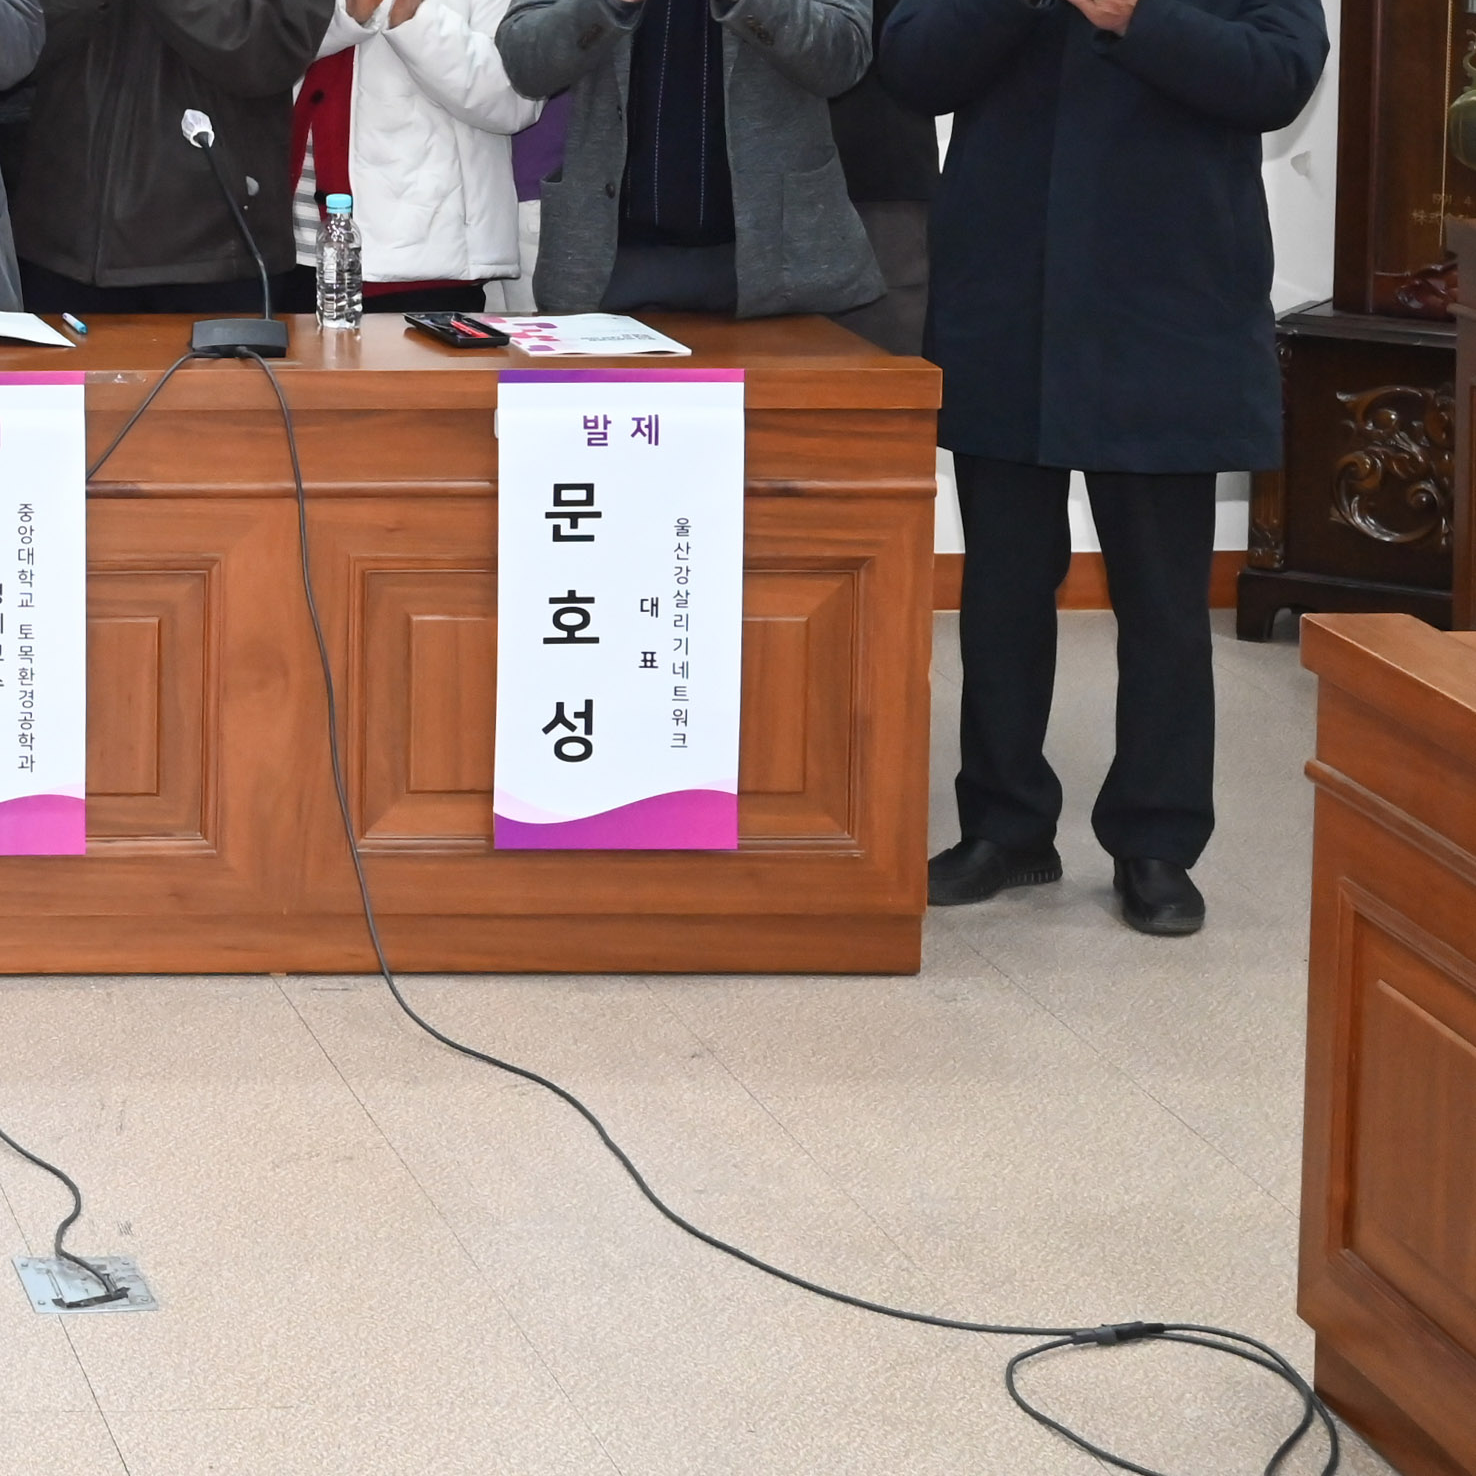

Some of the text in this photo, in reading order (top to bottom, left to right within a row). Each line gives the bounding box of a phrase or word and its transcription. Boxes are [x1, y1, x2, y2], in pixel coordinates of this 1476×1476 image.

[582, 414, 660, 447] 발제
[17, 503, 36, 774] 중앙대학교 토목환경공학과
[541, 482, 603, 763] 문호성
[638, 596, 659, 669] 대표
[671, 517, 692, 749] 울산강살리기네트워크
